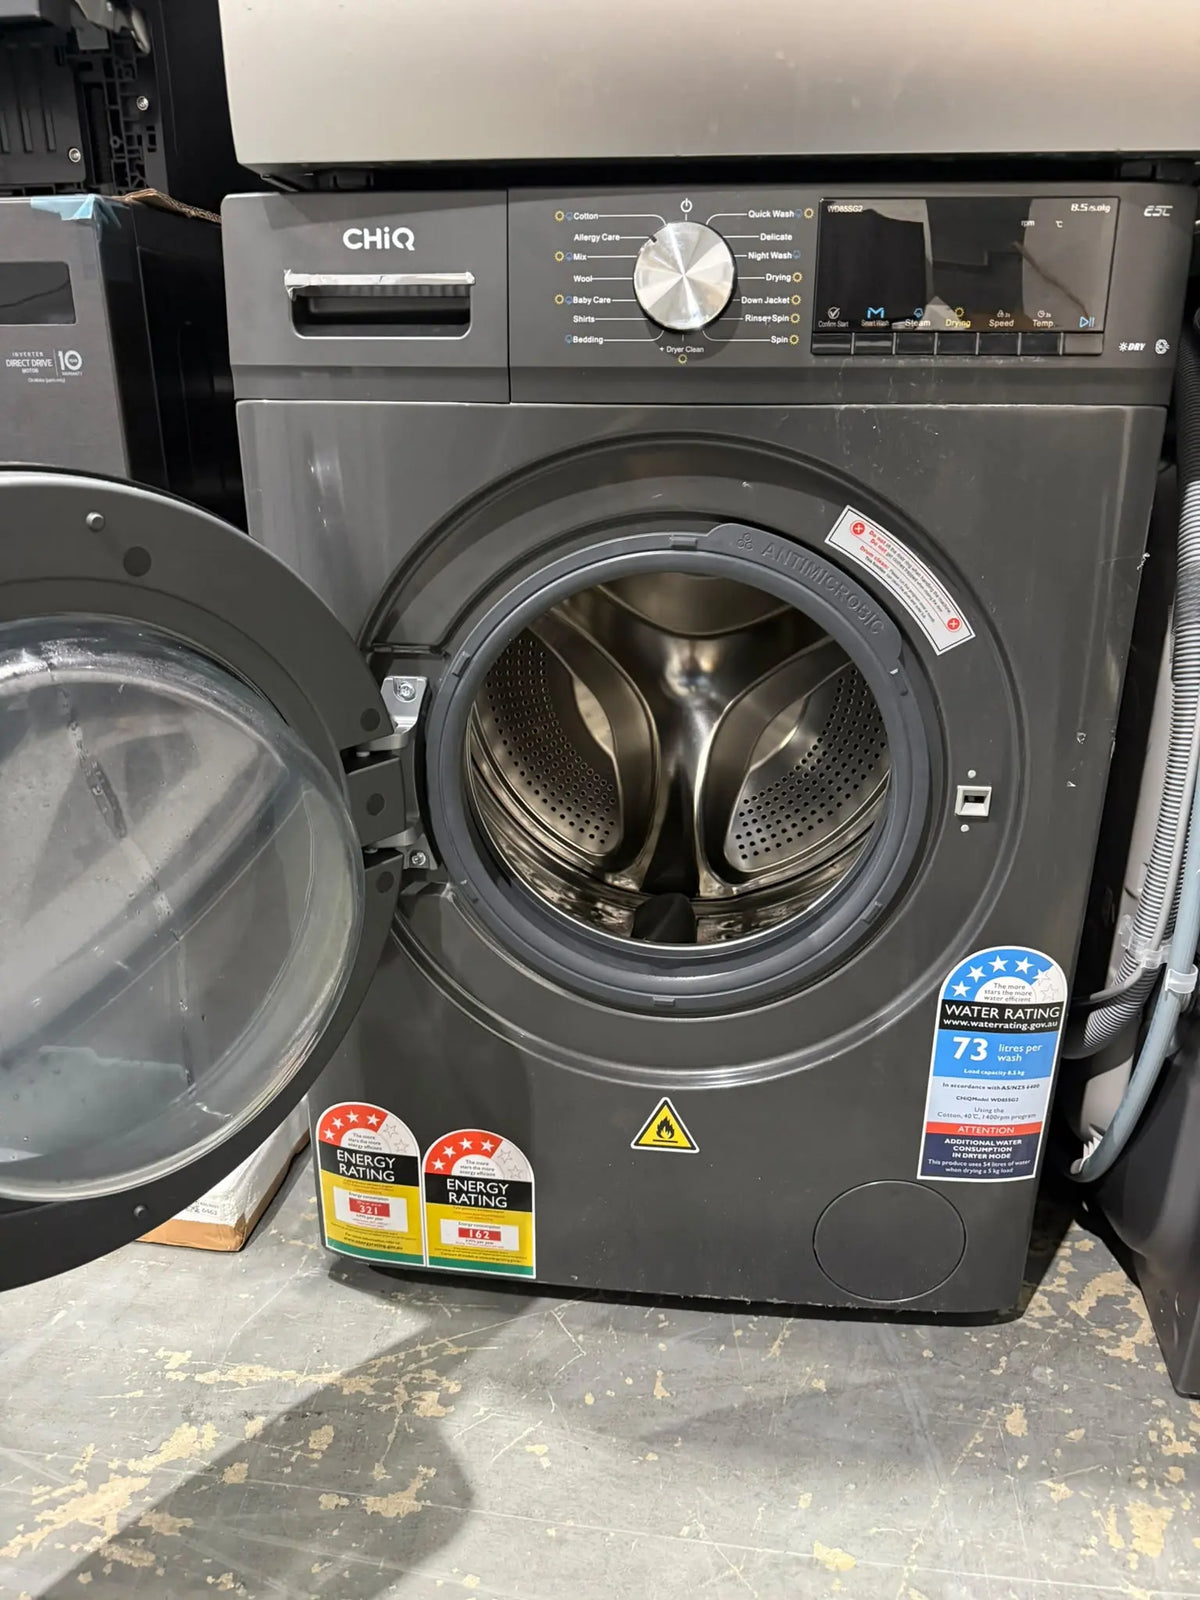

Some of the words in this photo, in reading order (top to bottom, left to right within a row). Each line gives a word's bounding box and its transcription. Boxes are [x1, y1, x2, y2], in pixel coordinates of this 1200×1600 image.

[573, 212, 598, 220] Cotton
[748, 210, 770, 218] Quick
[1021, 219, 1035, 227] rpm
[343, 226, 415, 250] CHiQ
[574, 234, 600, 243] Allergy
[748, 251, 770, 260] Night
[766, 274, 791, 282] Drying
[573, 297, 592, 306] Baby
[573, 315, 595, 323] Shirts
[904, 319, 931, 327] Steam
[945, 318, 970, 329] Drying
[818, 320, 836, 328] Confirm
[837, 320, 849, 328] Start
[989, 319, 1014, 329] Speed
[573, 335, 603, 345] Bedding
[771, 336, 788, 344] Spin
[666, 346, 684, 354] Dryer
[1127, 342, 1146, 351] DRY
[6, 359, 30, 367] DIRECT
[31, 359, 53, 367] DRIVE
[58, 350, 82, 371] 10
[869, 530, 876, 538] Do
[876, 535, 886, 544] not
[859, 545, 873, 558] Drum
[877, 544, 886, 552] not
[762, 543, 885, 635] ANTIMICROBIC
[945, 1003, 999, 1020] WATER
[1004, 1006, 1060, 1020] RATING
[943, 1017, 1058, 1031] www.waterrating.gov.au
[952, 1036, 989, 1062] 73
[998, 1043, 1024, 1052] litres
[1026, 1044, 1042, 1054] per
[997, 1053, 1022, 1062] wash
[981, 1069, 1006, 1077] capacity
[974, 1106, 993, 1114] Using
[937, 1111, 963, 1119] Cotton,
[957, 1125, 1016, 1134] ATTENTION
[944, 1138, 995, 1146] ADDITIONAL
[953, 1145, 1013, 1153] CONSUMPTION
[336, 1149, 396, 1169] ENERGY
[339, 1163, 395, 1182] RATING
[963, 1167, 982, 1175] drying
[446, 1178, 509, 1195] ENERGY
[448, 1191, 508, 1208] RATING
[359, 1204, 379, 1215] 321
[469, 1229, 490, 1240] 162
